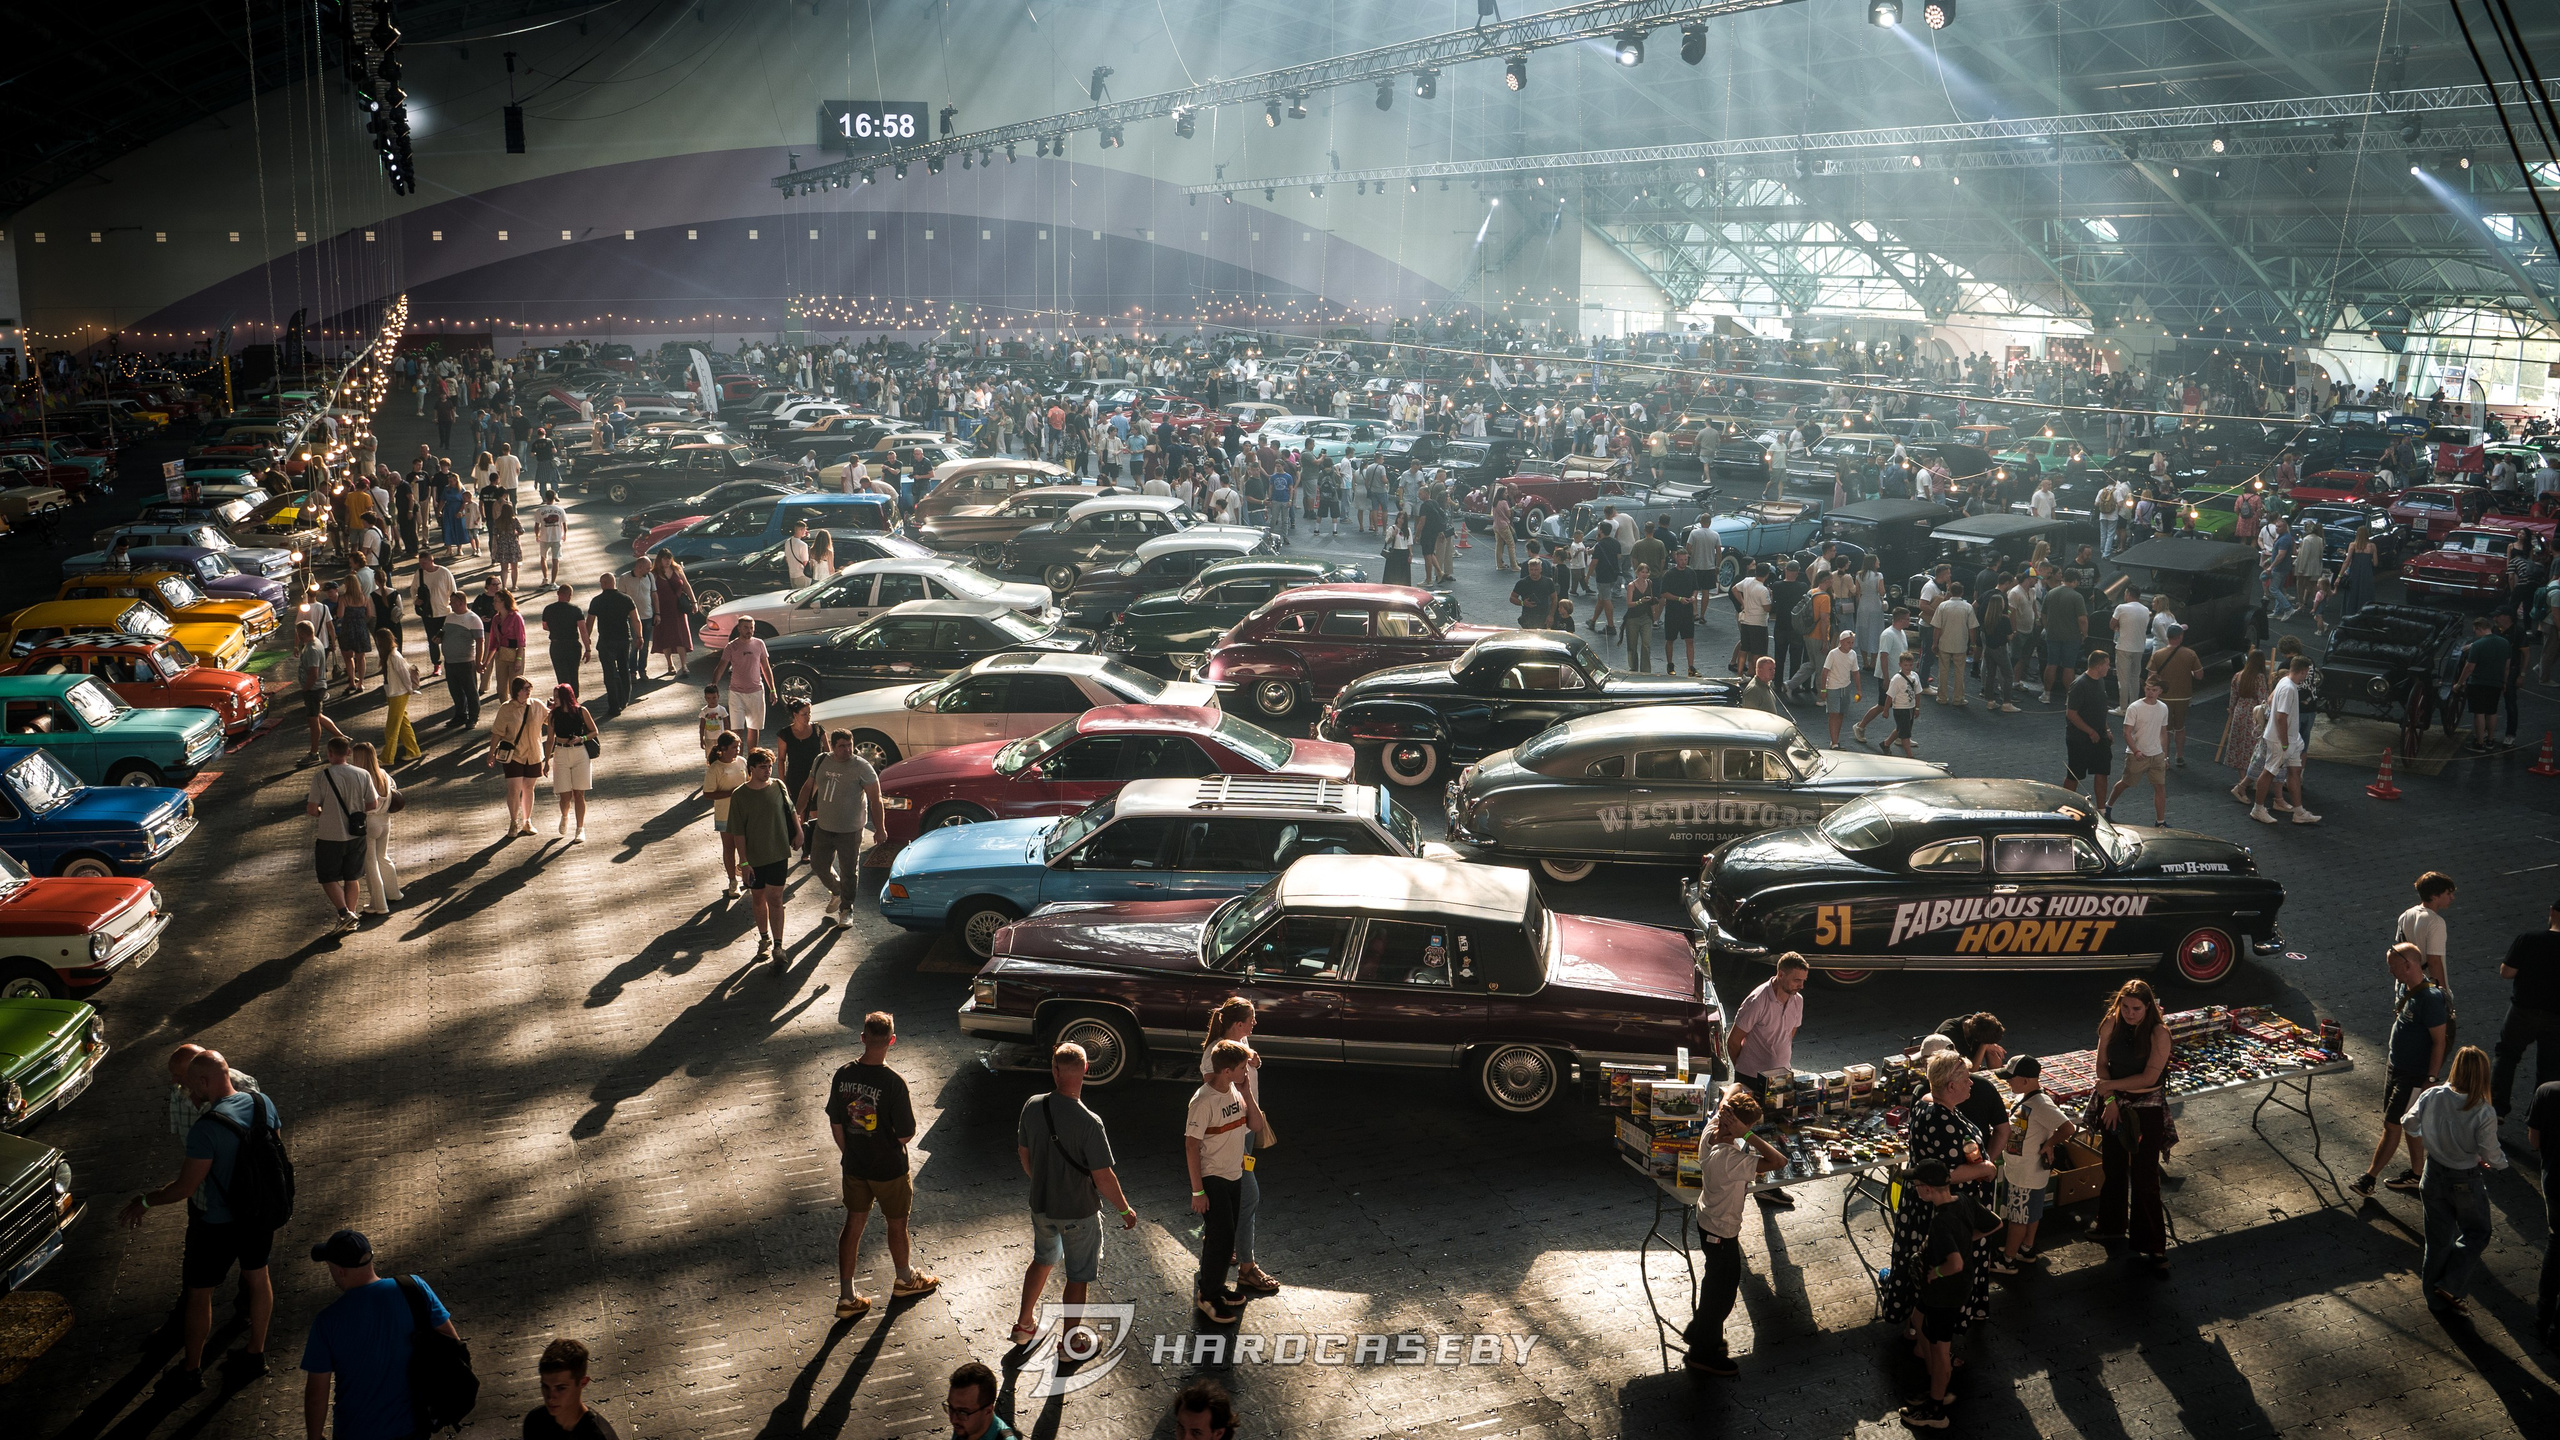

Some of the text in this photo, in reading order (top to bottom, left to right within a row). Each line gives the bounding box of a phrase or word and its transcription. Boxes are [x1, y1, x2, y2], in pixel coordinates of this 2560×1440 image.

[839, 113, 915, 137] 16:58
[1961, 810, 2043, 820] HUDSON HORNET
[1669, 832, 1693, 841] АВТО
[1695, 832, 1714, 842] ПОД
[2160, 861, 2230, 874] TWIN H-POWER
[1814, 905, 1853, 946] 51
[1887, 895, 2149, 947] FABULOUS HUDSON
[1955, 920, 2117, 952] HORNET
